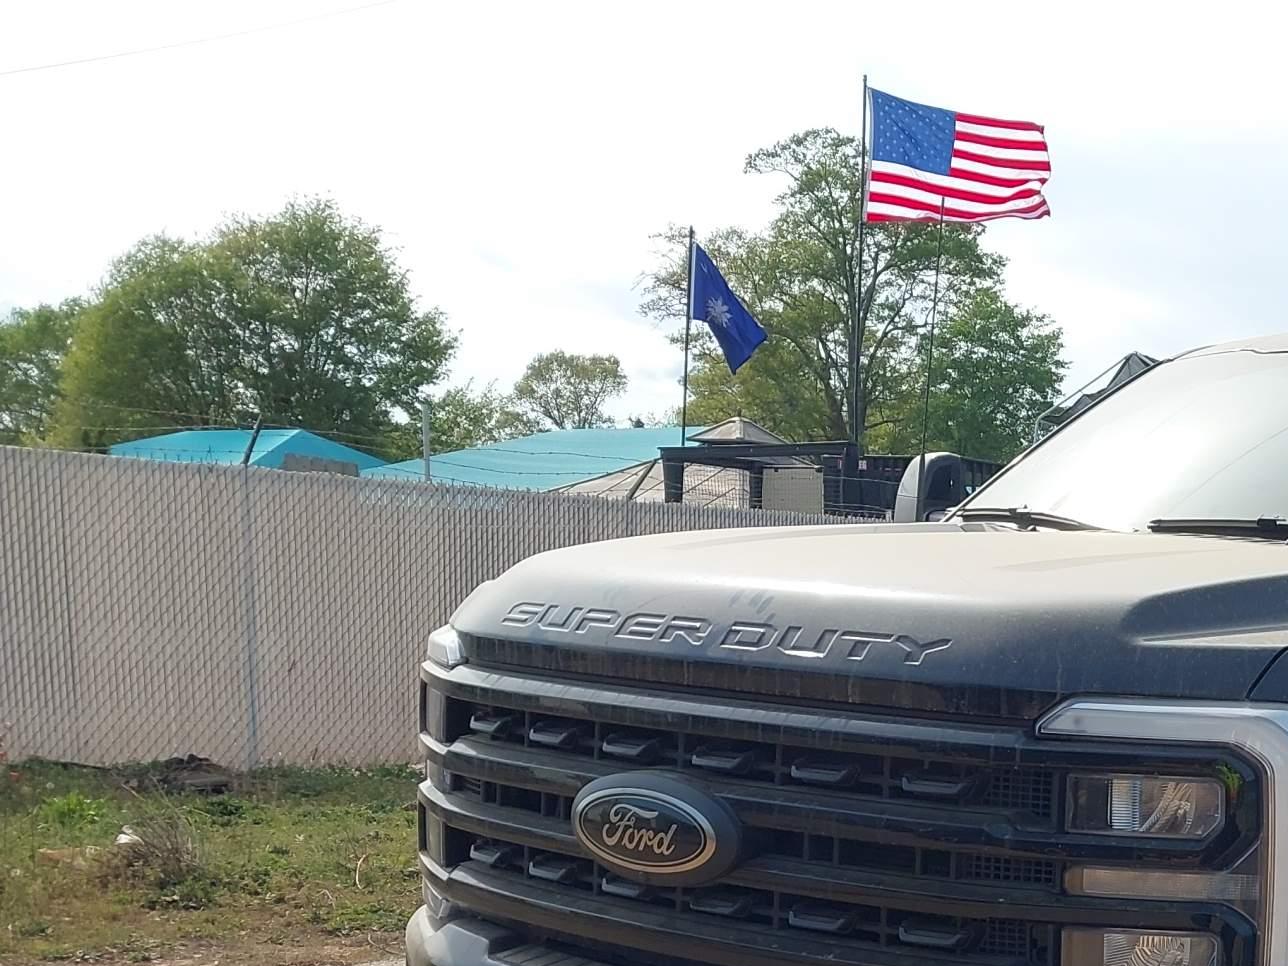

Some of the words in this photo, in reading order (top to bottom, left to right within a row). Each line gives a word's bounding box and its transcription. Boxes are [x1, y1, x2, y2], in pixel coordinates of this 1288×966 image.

[501, 601, 713, 645] SUPER
[719, 620, 953, 666] DUTY
[602, 803, 678, 857] Ford
